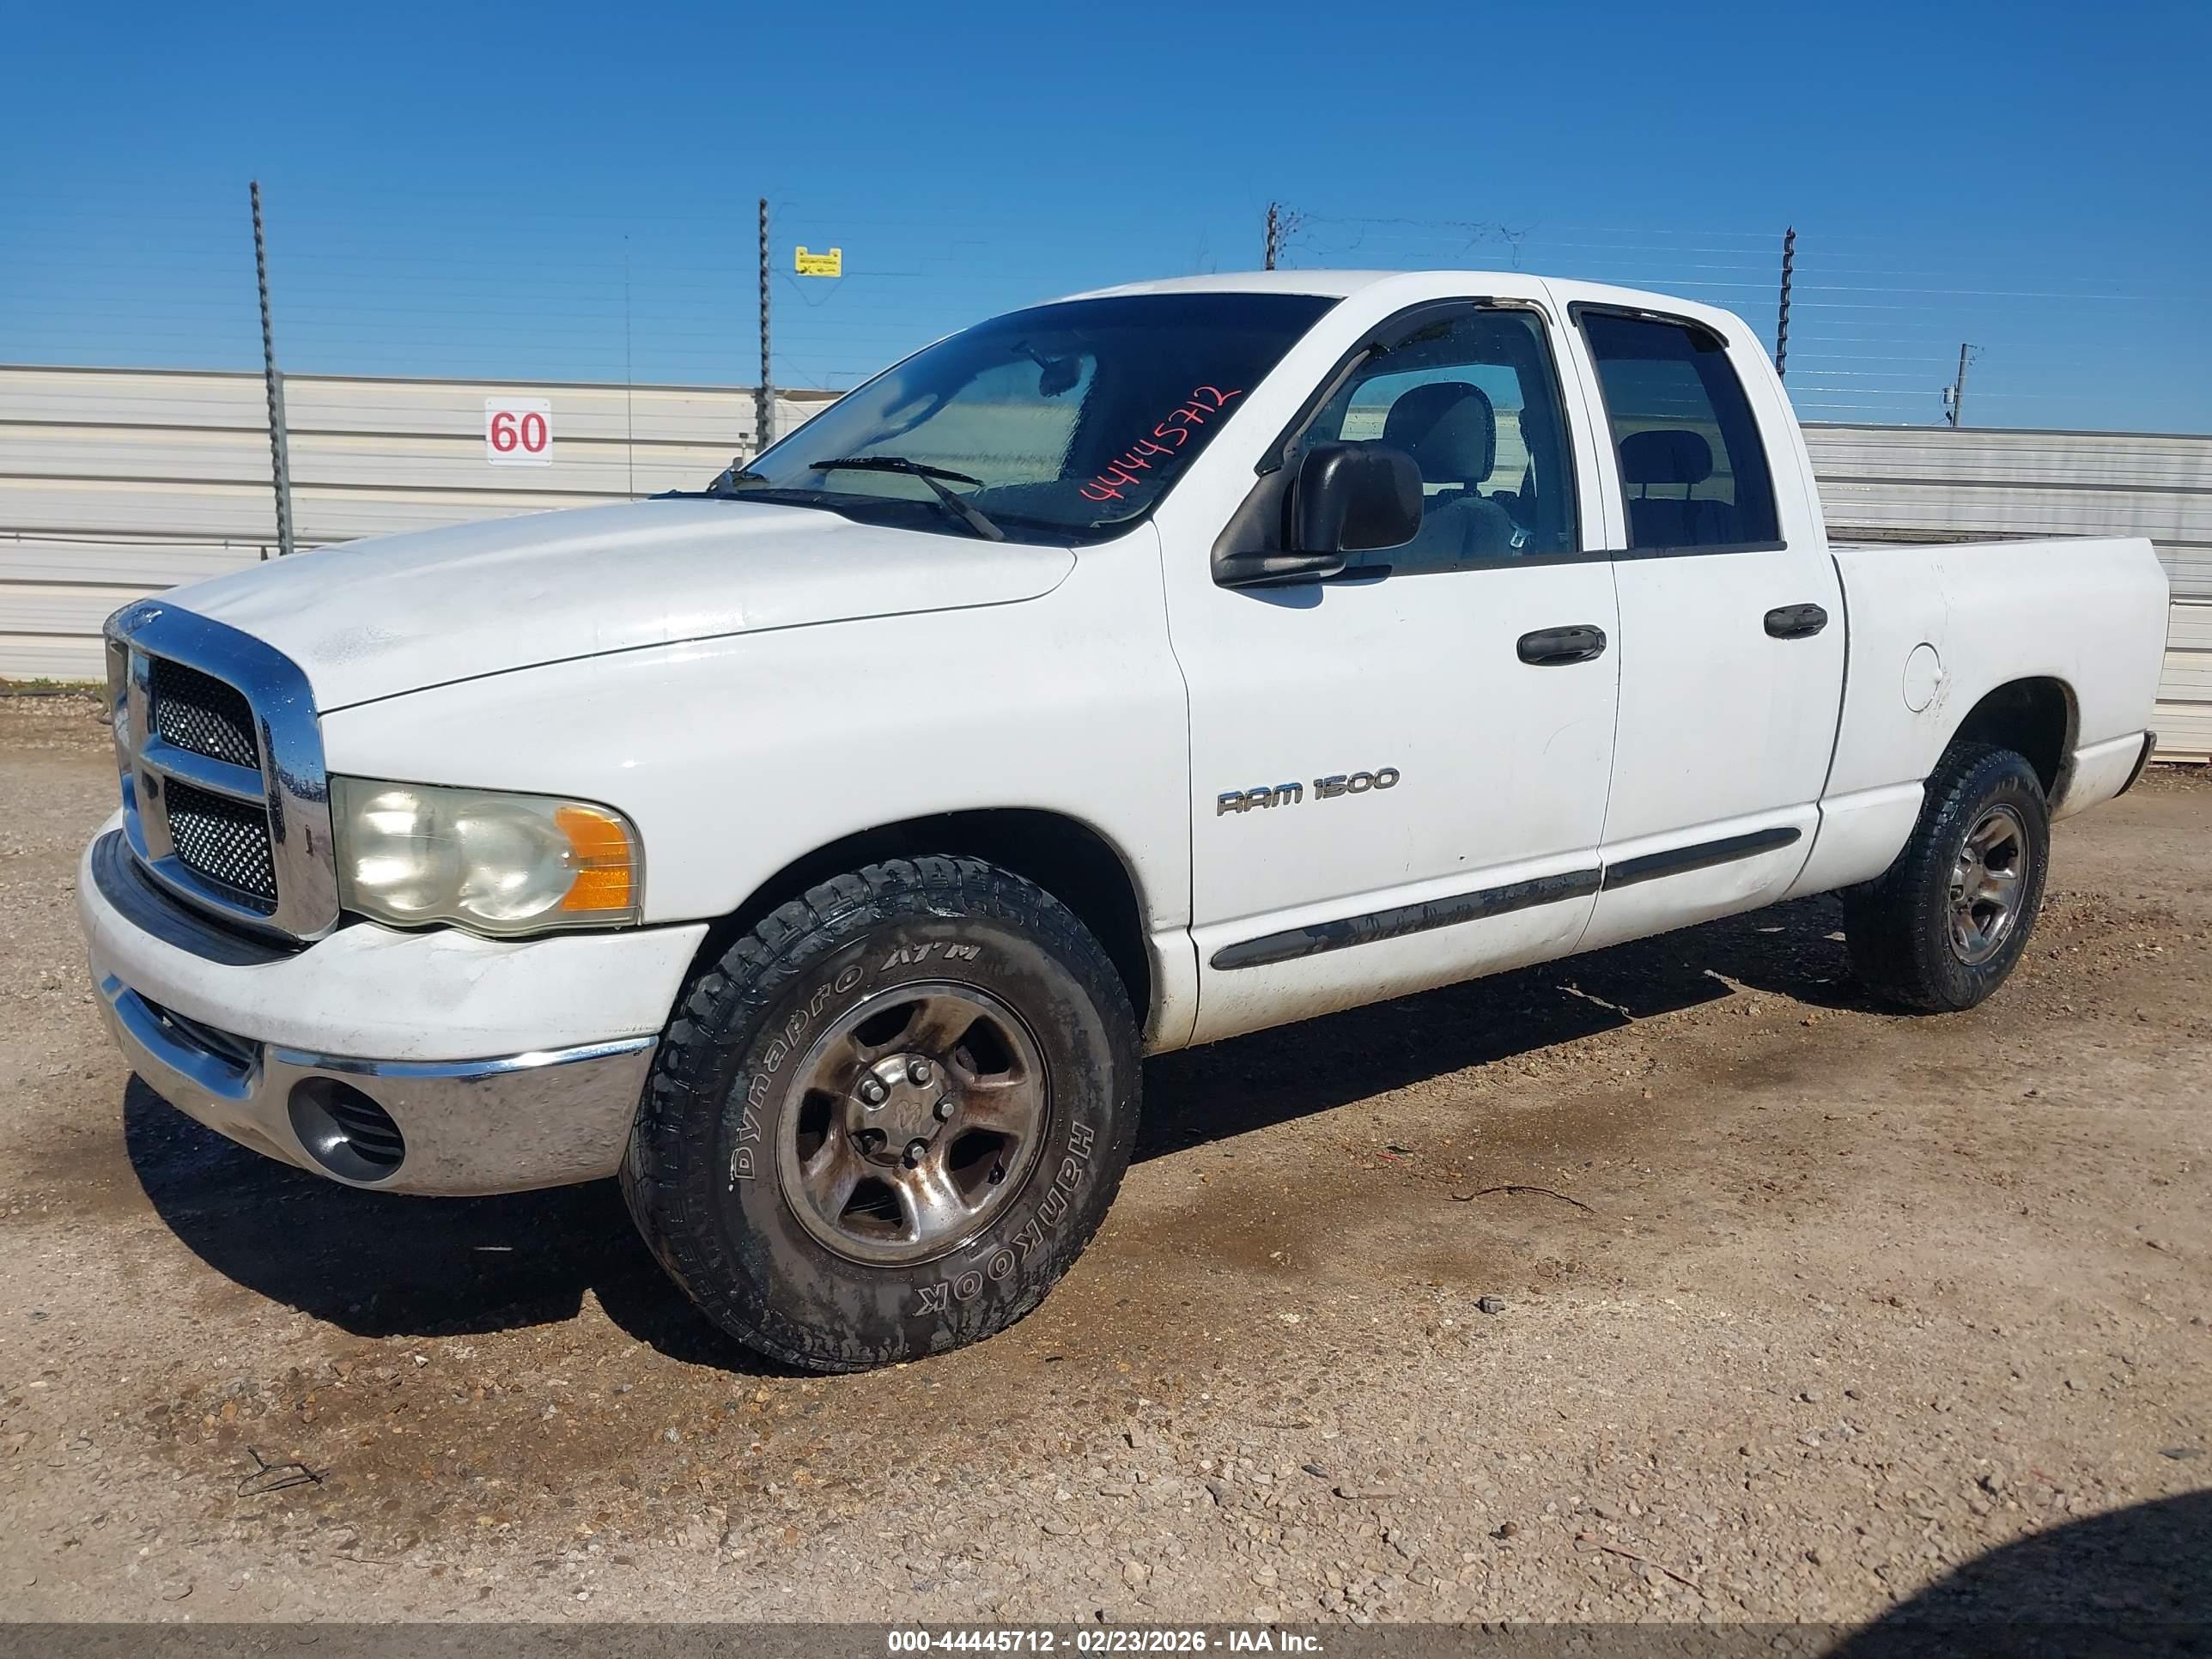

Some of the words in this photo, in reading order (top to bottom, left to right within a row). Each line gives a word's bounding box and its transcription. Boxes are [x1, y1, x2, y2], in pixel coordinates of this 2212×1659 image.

[492, 412, 546, 453] 60
[1080, 386, 1242, 501] 44445712
[1217, 782, 1304, 816] RAM
[1314, 767, 1401, 800] 1500
